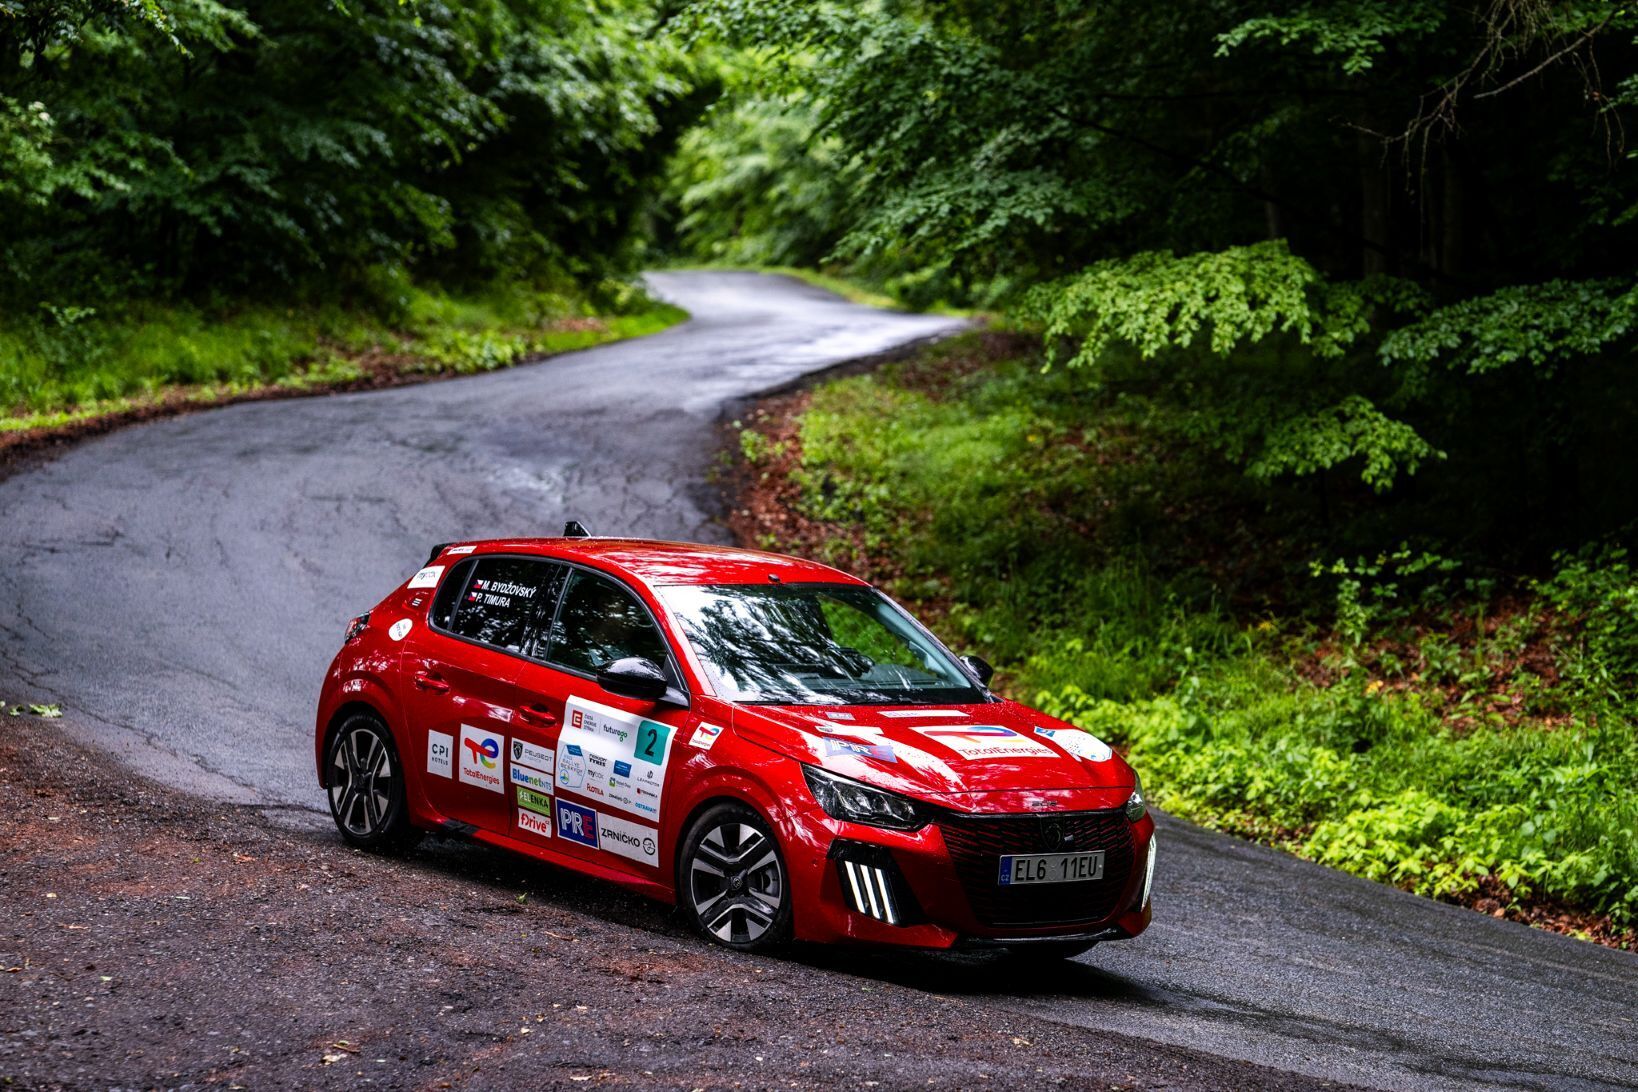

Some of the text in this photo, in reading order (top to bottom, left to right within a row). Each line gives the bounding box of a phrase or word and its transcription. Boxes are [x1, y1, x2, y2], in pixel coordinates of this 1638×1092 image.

[481, 580, 537, 599] M. BYDŽOVSKÝ
[475, 592, 511, 608] P. TIMURA
[431, 743, 449, 758] CPI
[644, 728, 658, 757] 2
[959, 746, 1054, 756] TotalEnergies
[524, 748, 553, 762] PEUGEOT
[463, 767, 500, 785] TotalEnergies
[560, 807, 594, 839] PRE
[601, 827, 641, 848] ZRNÍČKO
[1015, 858, 1047, 881] EL6
[1060, 855, 1098, 879] 11EU
